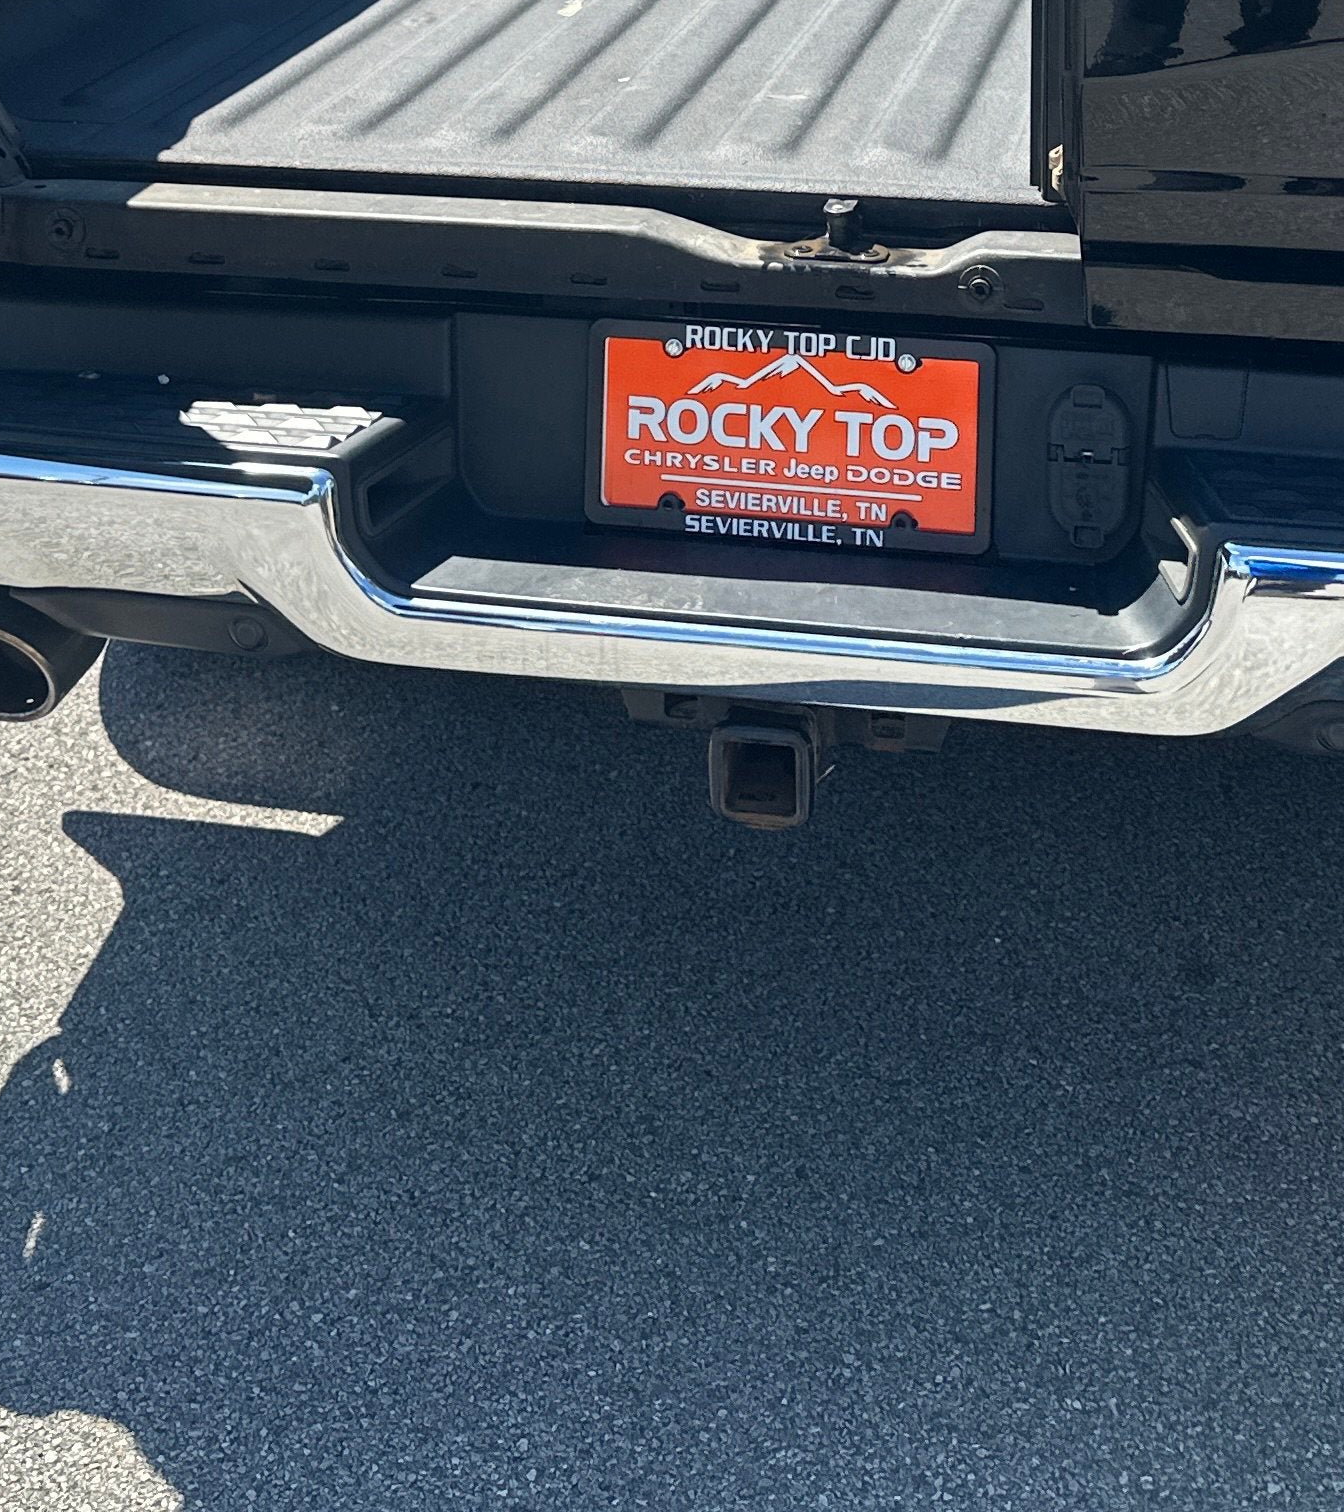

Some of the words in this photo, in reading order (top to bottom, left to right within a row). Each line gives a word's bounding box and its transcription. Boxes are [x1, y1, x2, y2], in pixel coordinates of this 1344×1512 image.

[685, 324, 774, 354] ROCKY
[783, 331, 837, 358] TOP
[846, 336, 896, 362] CJD
[627, 395, 824, 453] ROCKY
[835, 411, 959, 463] TOP
[624, 449, 776, 477] CHRYSLER
[782, 462, 838, 483] Jeep
[846, 465, 962, 490] DODGE
[695, 489, 848, 521] SEVIERVILLE,
[857, 502, 887, 522] TN
[685, 514, 842, 546] SEVIERVILLE,
[852, 528, 884, 547] TN
